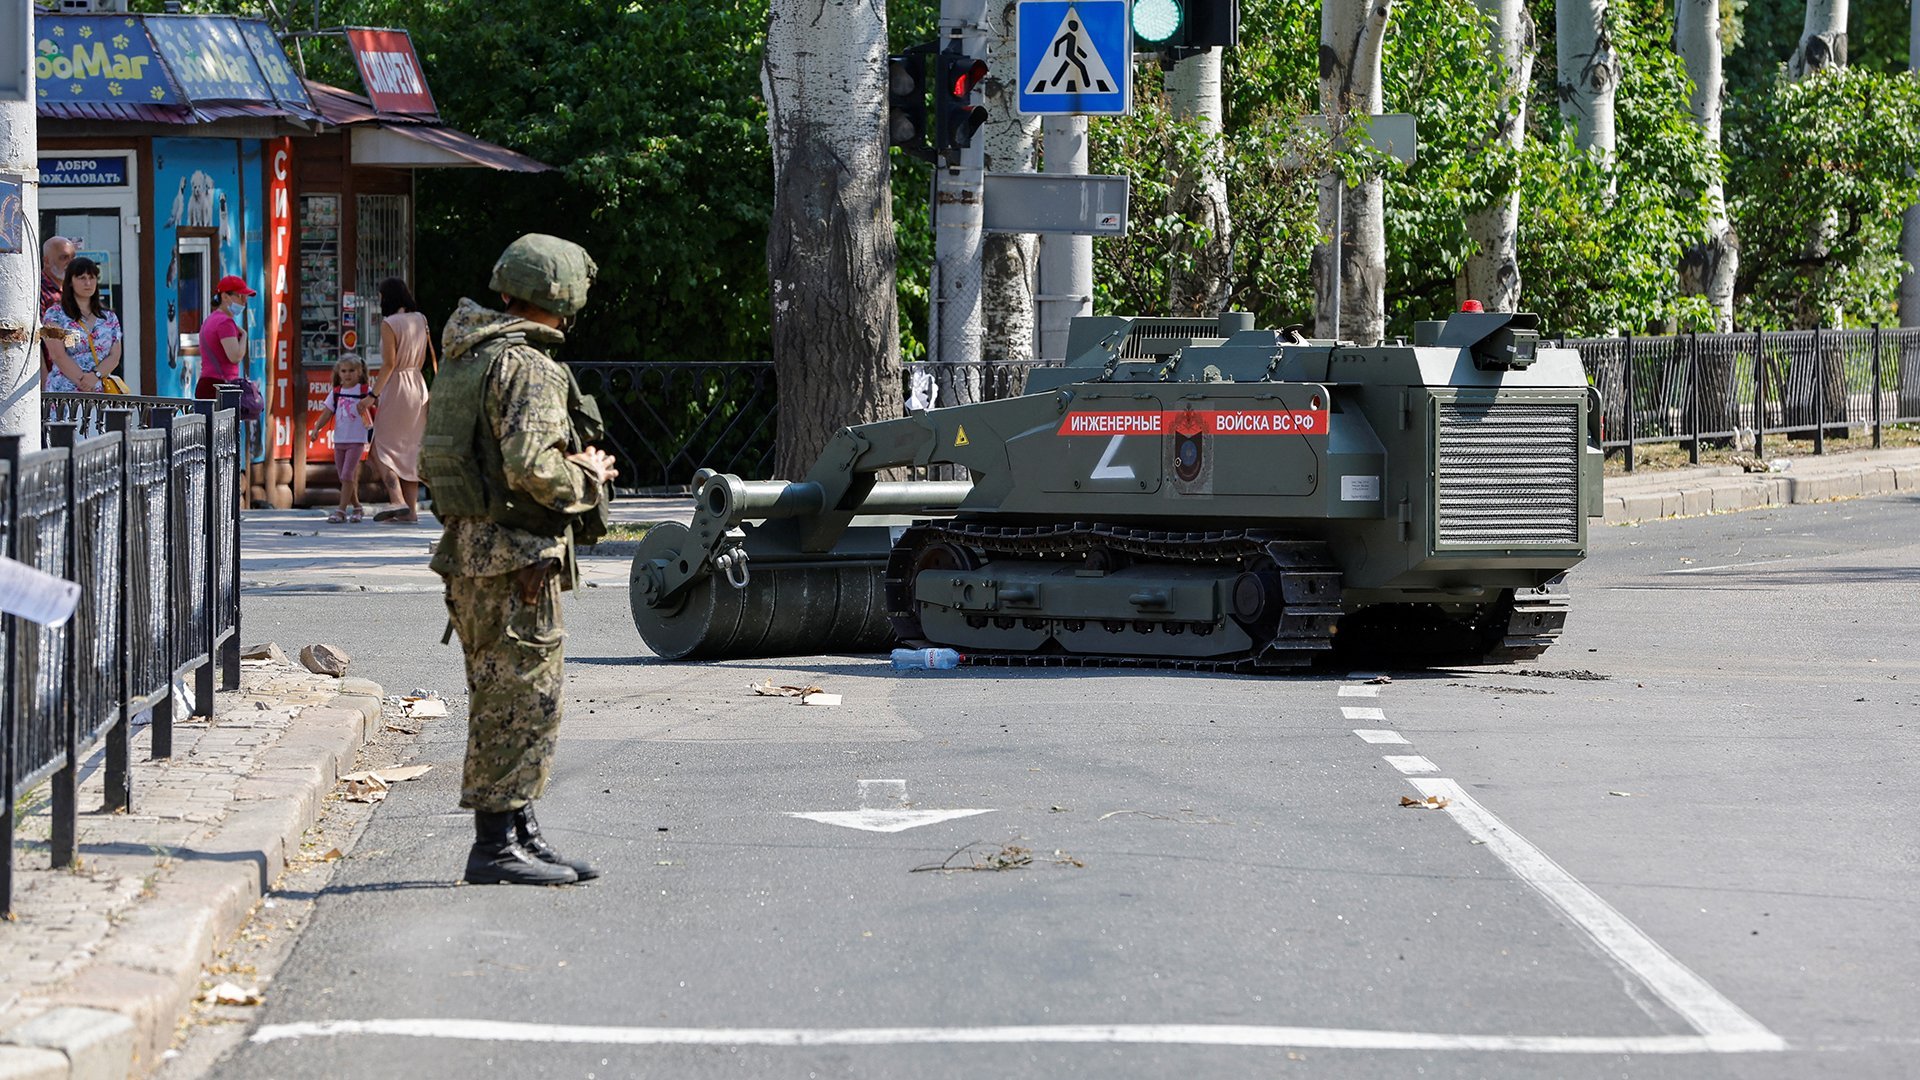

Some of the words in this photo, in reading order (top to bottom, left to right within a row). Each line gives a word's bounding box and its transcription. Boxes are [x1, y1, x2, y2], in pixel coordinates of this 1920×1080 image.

[35, 42, 149, 79] ооМаг
[165, 39, 253, 83] ЗооМаг
[360, 50, 423, 94] СИГАРЕТЫ
[55, 160, 97, 172] ДОБРО
[40, 173, 120, 184] ОЖАЛОВАТЬ
[274, 149, 290, 446] СИГАРЕТЫ
[310, 382, 333, 394] РЕЖИ
[308, 400, 325, 411] РАБ
[1071, 415, 1161, 431] ИНЖЕНЕРНЫЕ
[1216, 411, 1270, 431] ВОЙСКА
[1273, 415, 1291, 430] ВС
[1294, 415, 1314, 430] РФ
